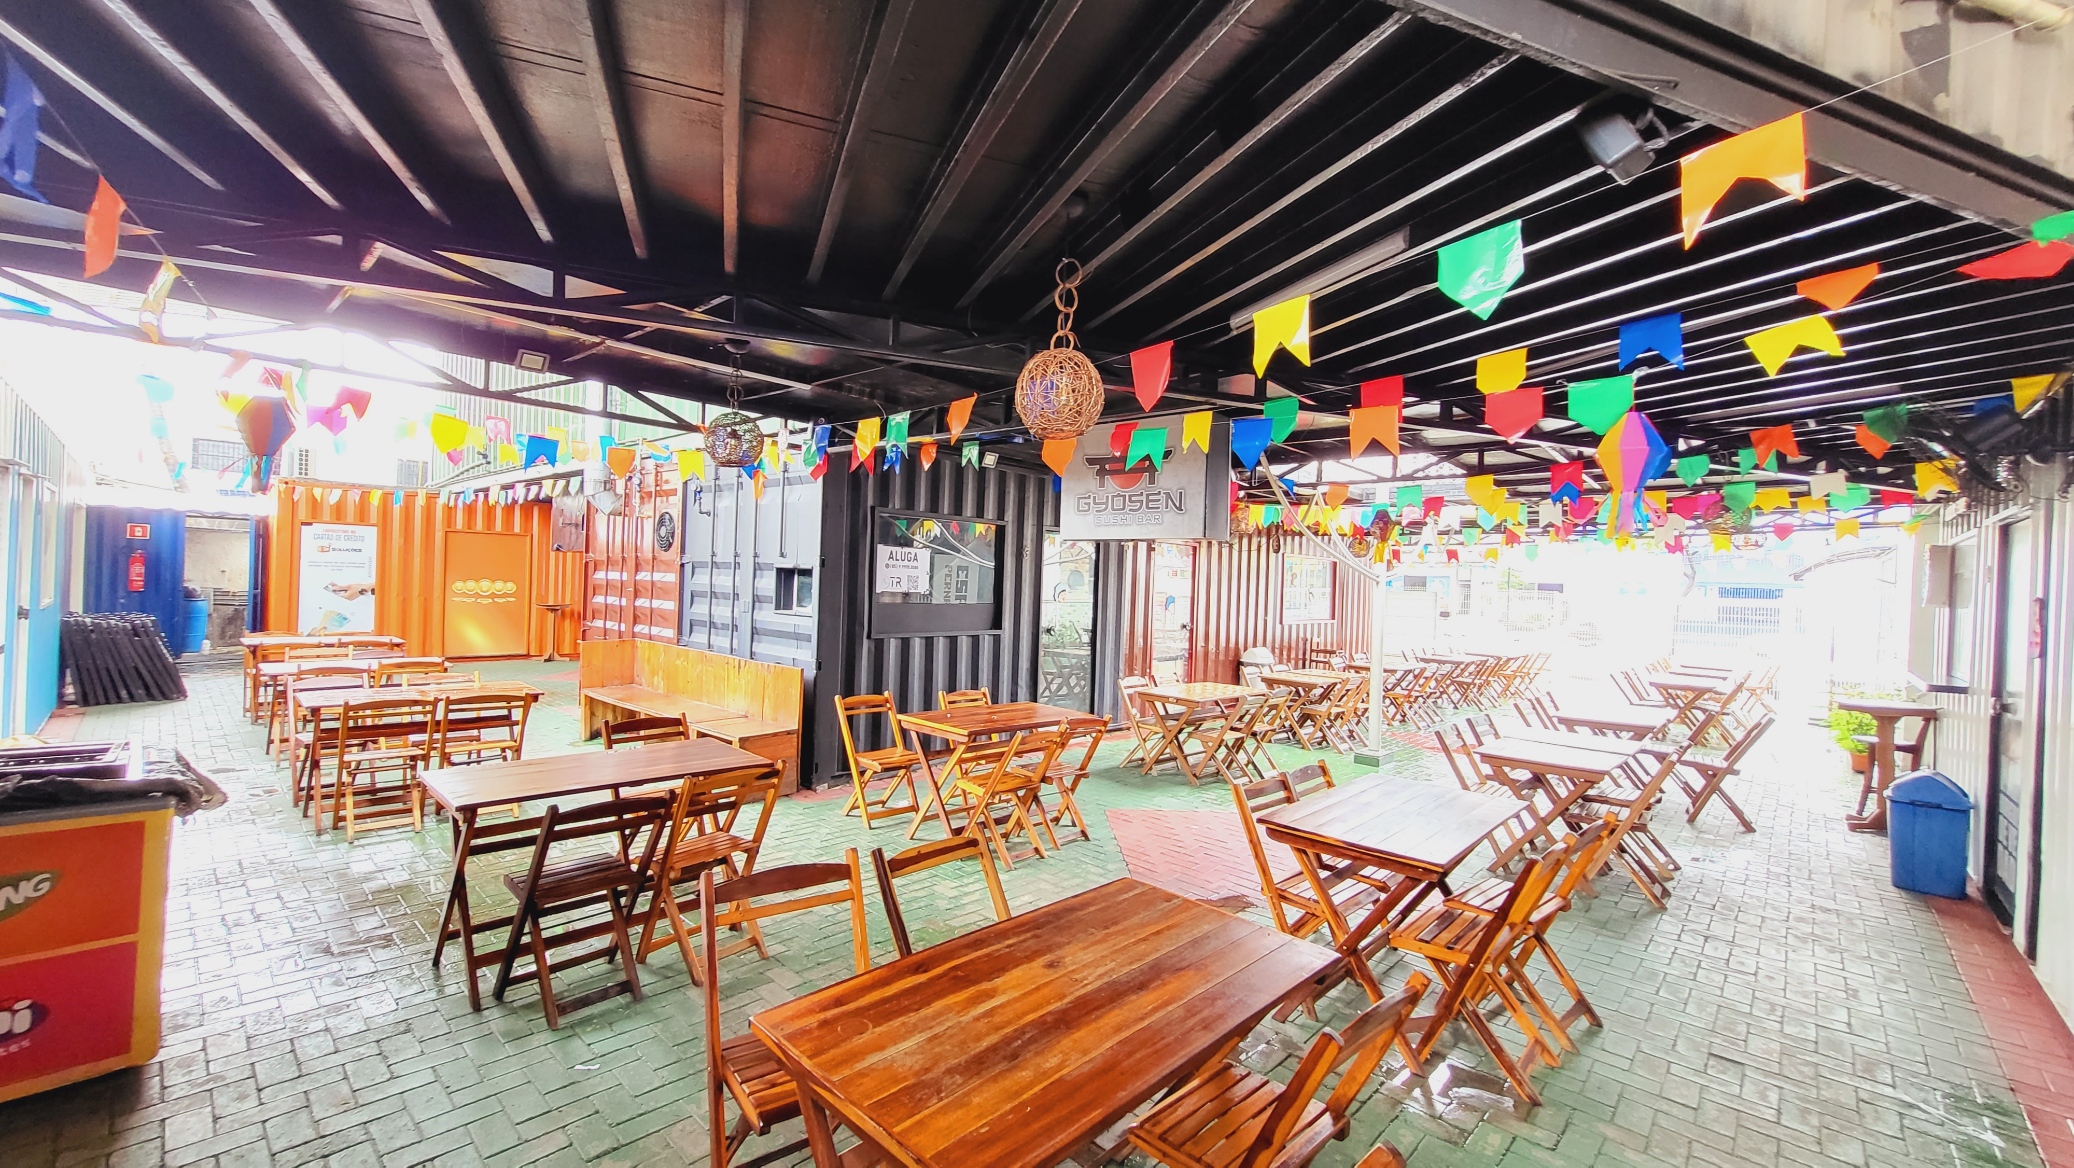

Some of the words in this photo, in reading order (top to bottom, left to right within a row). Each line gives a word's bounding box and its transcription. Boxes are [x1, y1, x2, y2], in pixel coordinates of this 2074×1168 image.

[1077, 490, 1183, 513] GYOSEN
[1096, 515, 1132, 525] SUSHI
[1137, 514, 1160, 524] BAR
[888, 550, 918, 562] ALUGA
[890, 577, 901, 587] TR
